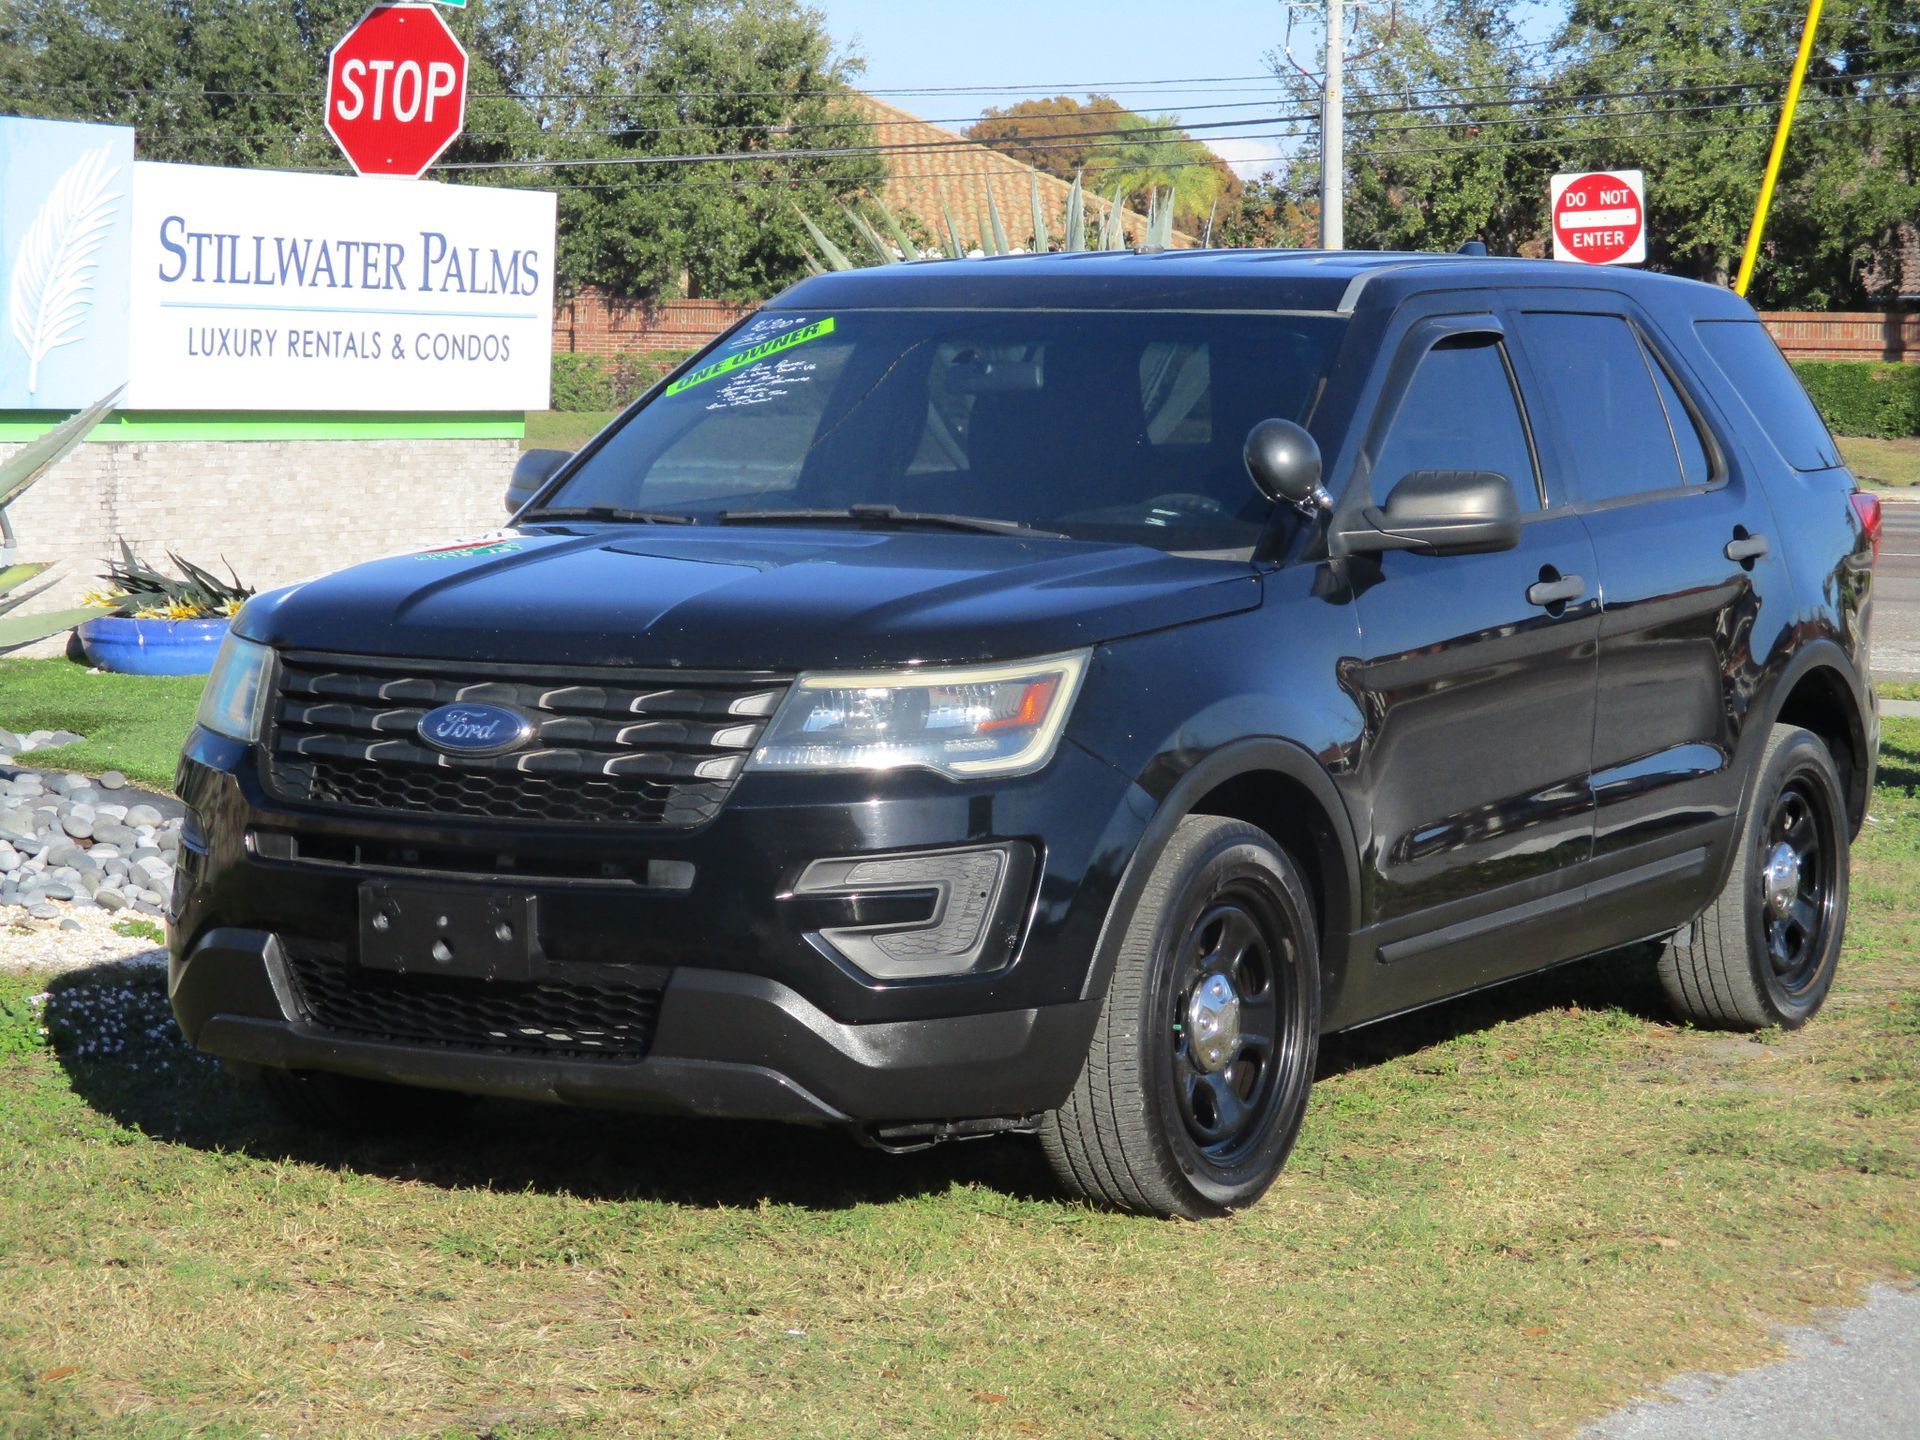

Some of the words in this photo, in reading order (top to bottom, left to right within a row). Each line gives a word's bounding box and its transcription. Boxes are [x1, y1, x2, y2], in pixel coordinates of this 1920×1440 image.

[337, 58, 456, 123] STOP
[1565, 191, 1587, 207] DO
[1600, 189, 1629, 205] NOT
[159, 215, 406, 290] STILLWATER
[418, 232, 539, 296] PALMS
[1573, 231, 1625, 248] ENTER
[188, 327, 278, 357] LUXURY
[288, 329, 381, 359] RENTALS
[391, 333, 406, 360] &
[415, 332, 510, 362] CONDOS
[676, 361, 728, 389] ONE
[732, 322, 819, 365] OWNER
[436, 710, 500, 738] Ford
